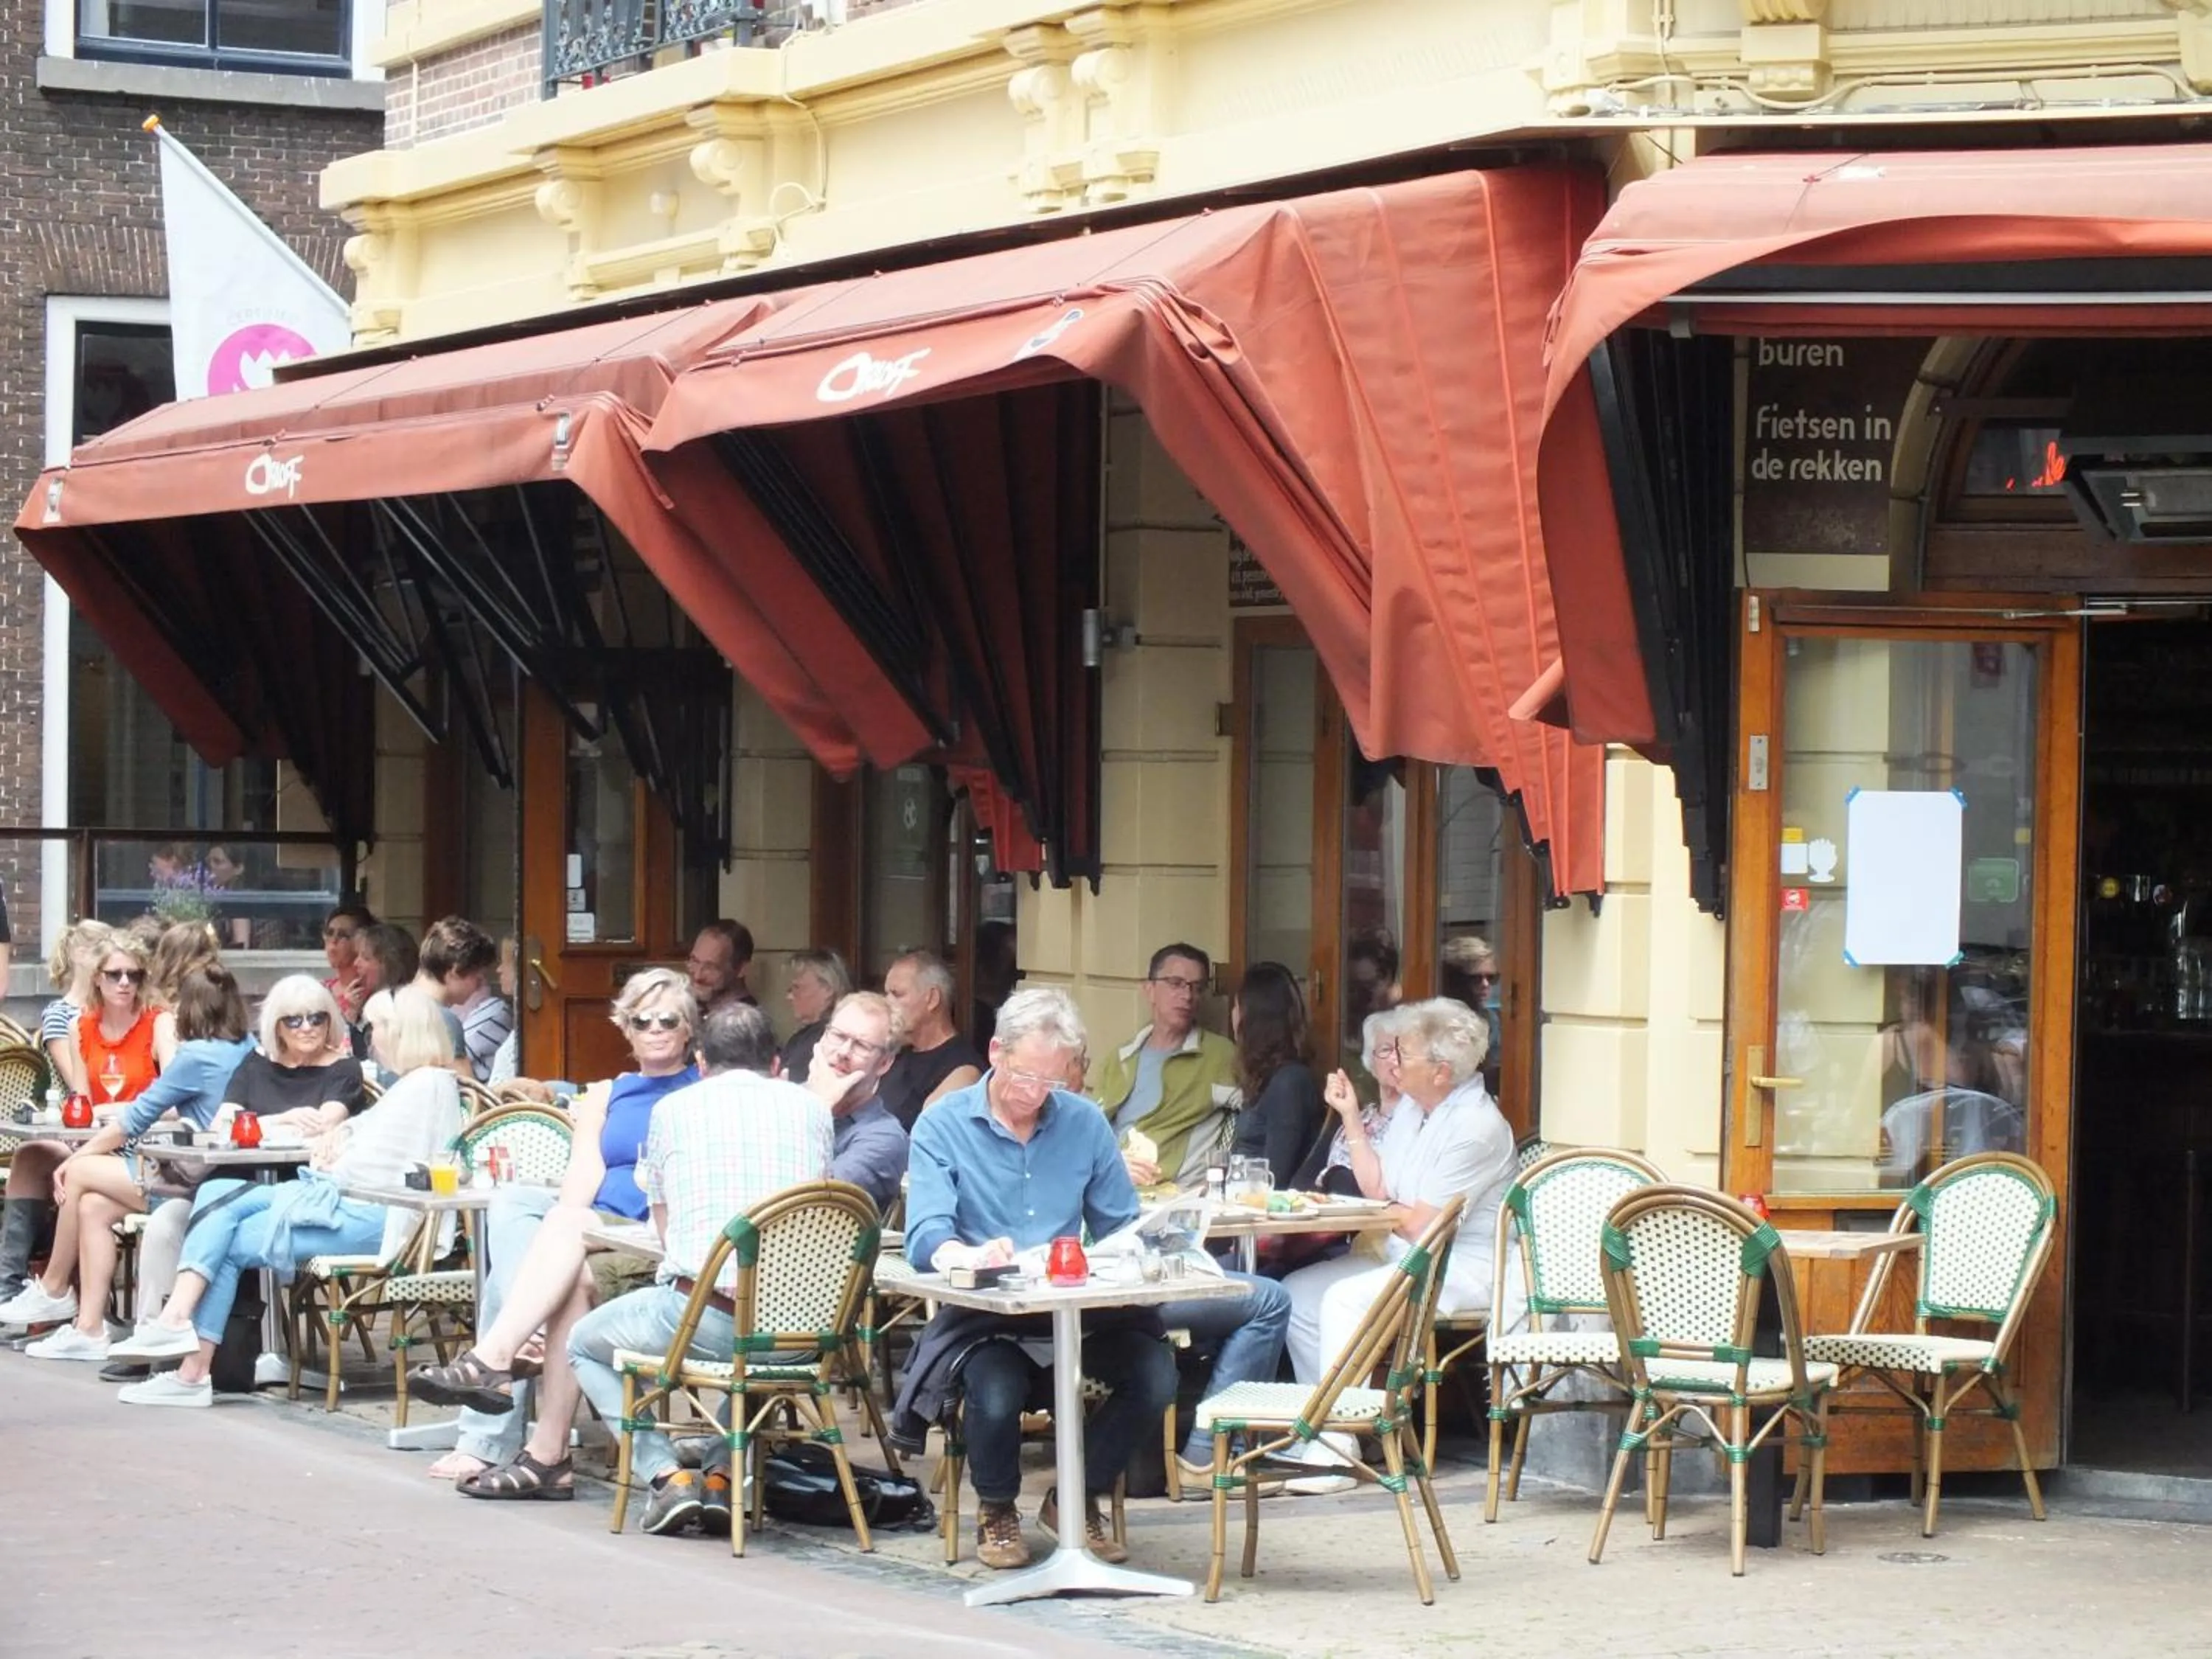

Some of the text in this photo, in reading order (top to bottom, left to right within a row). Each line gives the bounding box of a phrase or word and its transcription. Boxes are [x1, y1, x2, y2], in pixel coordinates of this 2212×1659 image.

[1758, 336, 1843, 366] buren
[1756, 403, 1892, 441] Fietsen in
[1751, 447, 1882, 481] de rekken
